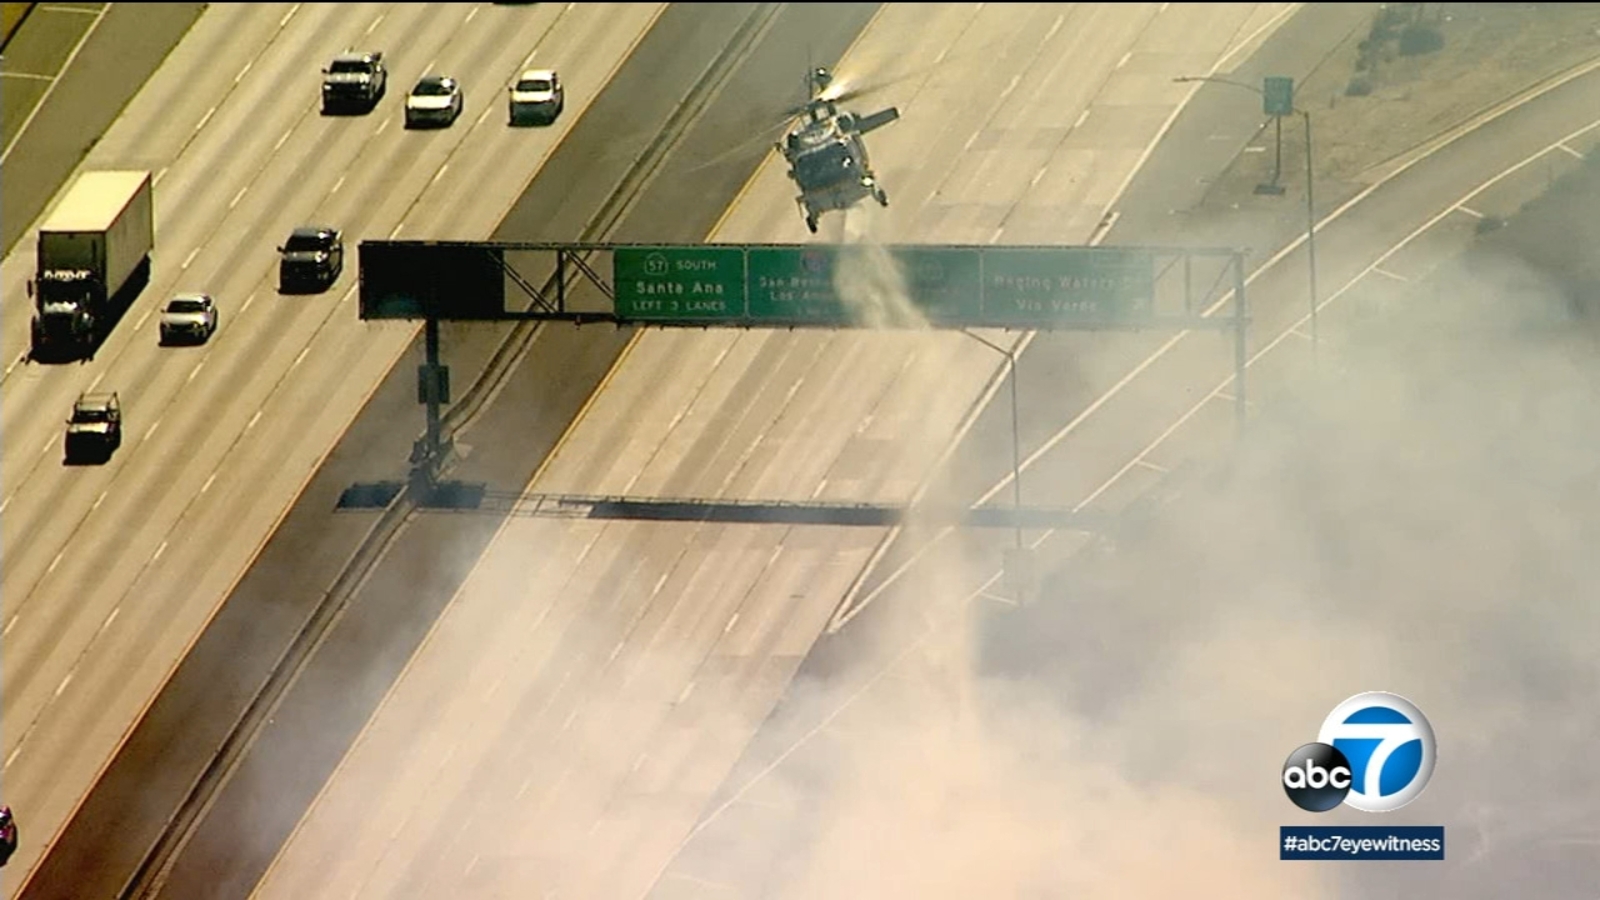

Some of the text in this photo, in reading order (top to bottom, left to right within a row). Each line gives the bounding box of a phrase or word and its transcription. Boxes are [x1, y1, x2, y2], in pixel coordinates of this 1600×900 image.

[648, 260, 717, 271] 57 SOUTH
[636, 281, 724, 294] Santa Ana
[633, 301, 727, 311] LEFT 3 LANES
[1015, 299, 1042, 310] Via
